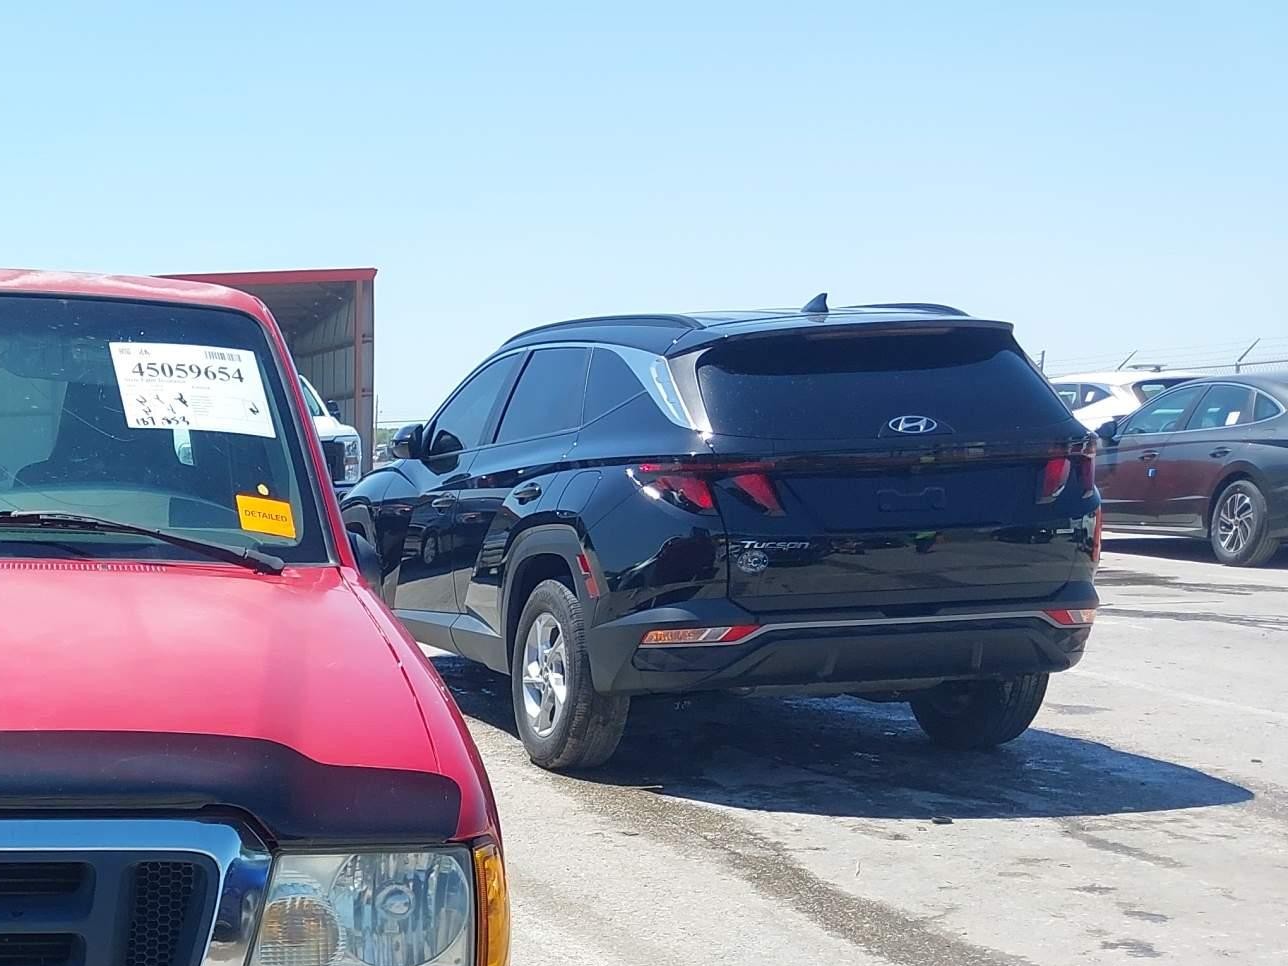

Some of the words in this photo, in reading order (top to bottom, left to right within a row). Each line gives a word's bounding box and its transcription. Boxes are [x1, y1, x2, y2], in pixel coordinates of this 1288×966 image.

[131, 362, 245, 382] 45059654
[244, 509, 288, 522] DETAILED
[740, 540, 810, 549] Tucson
